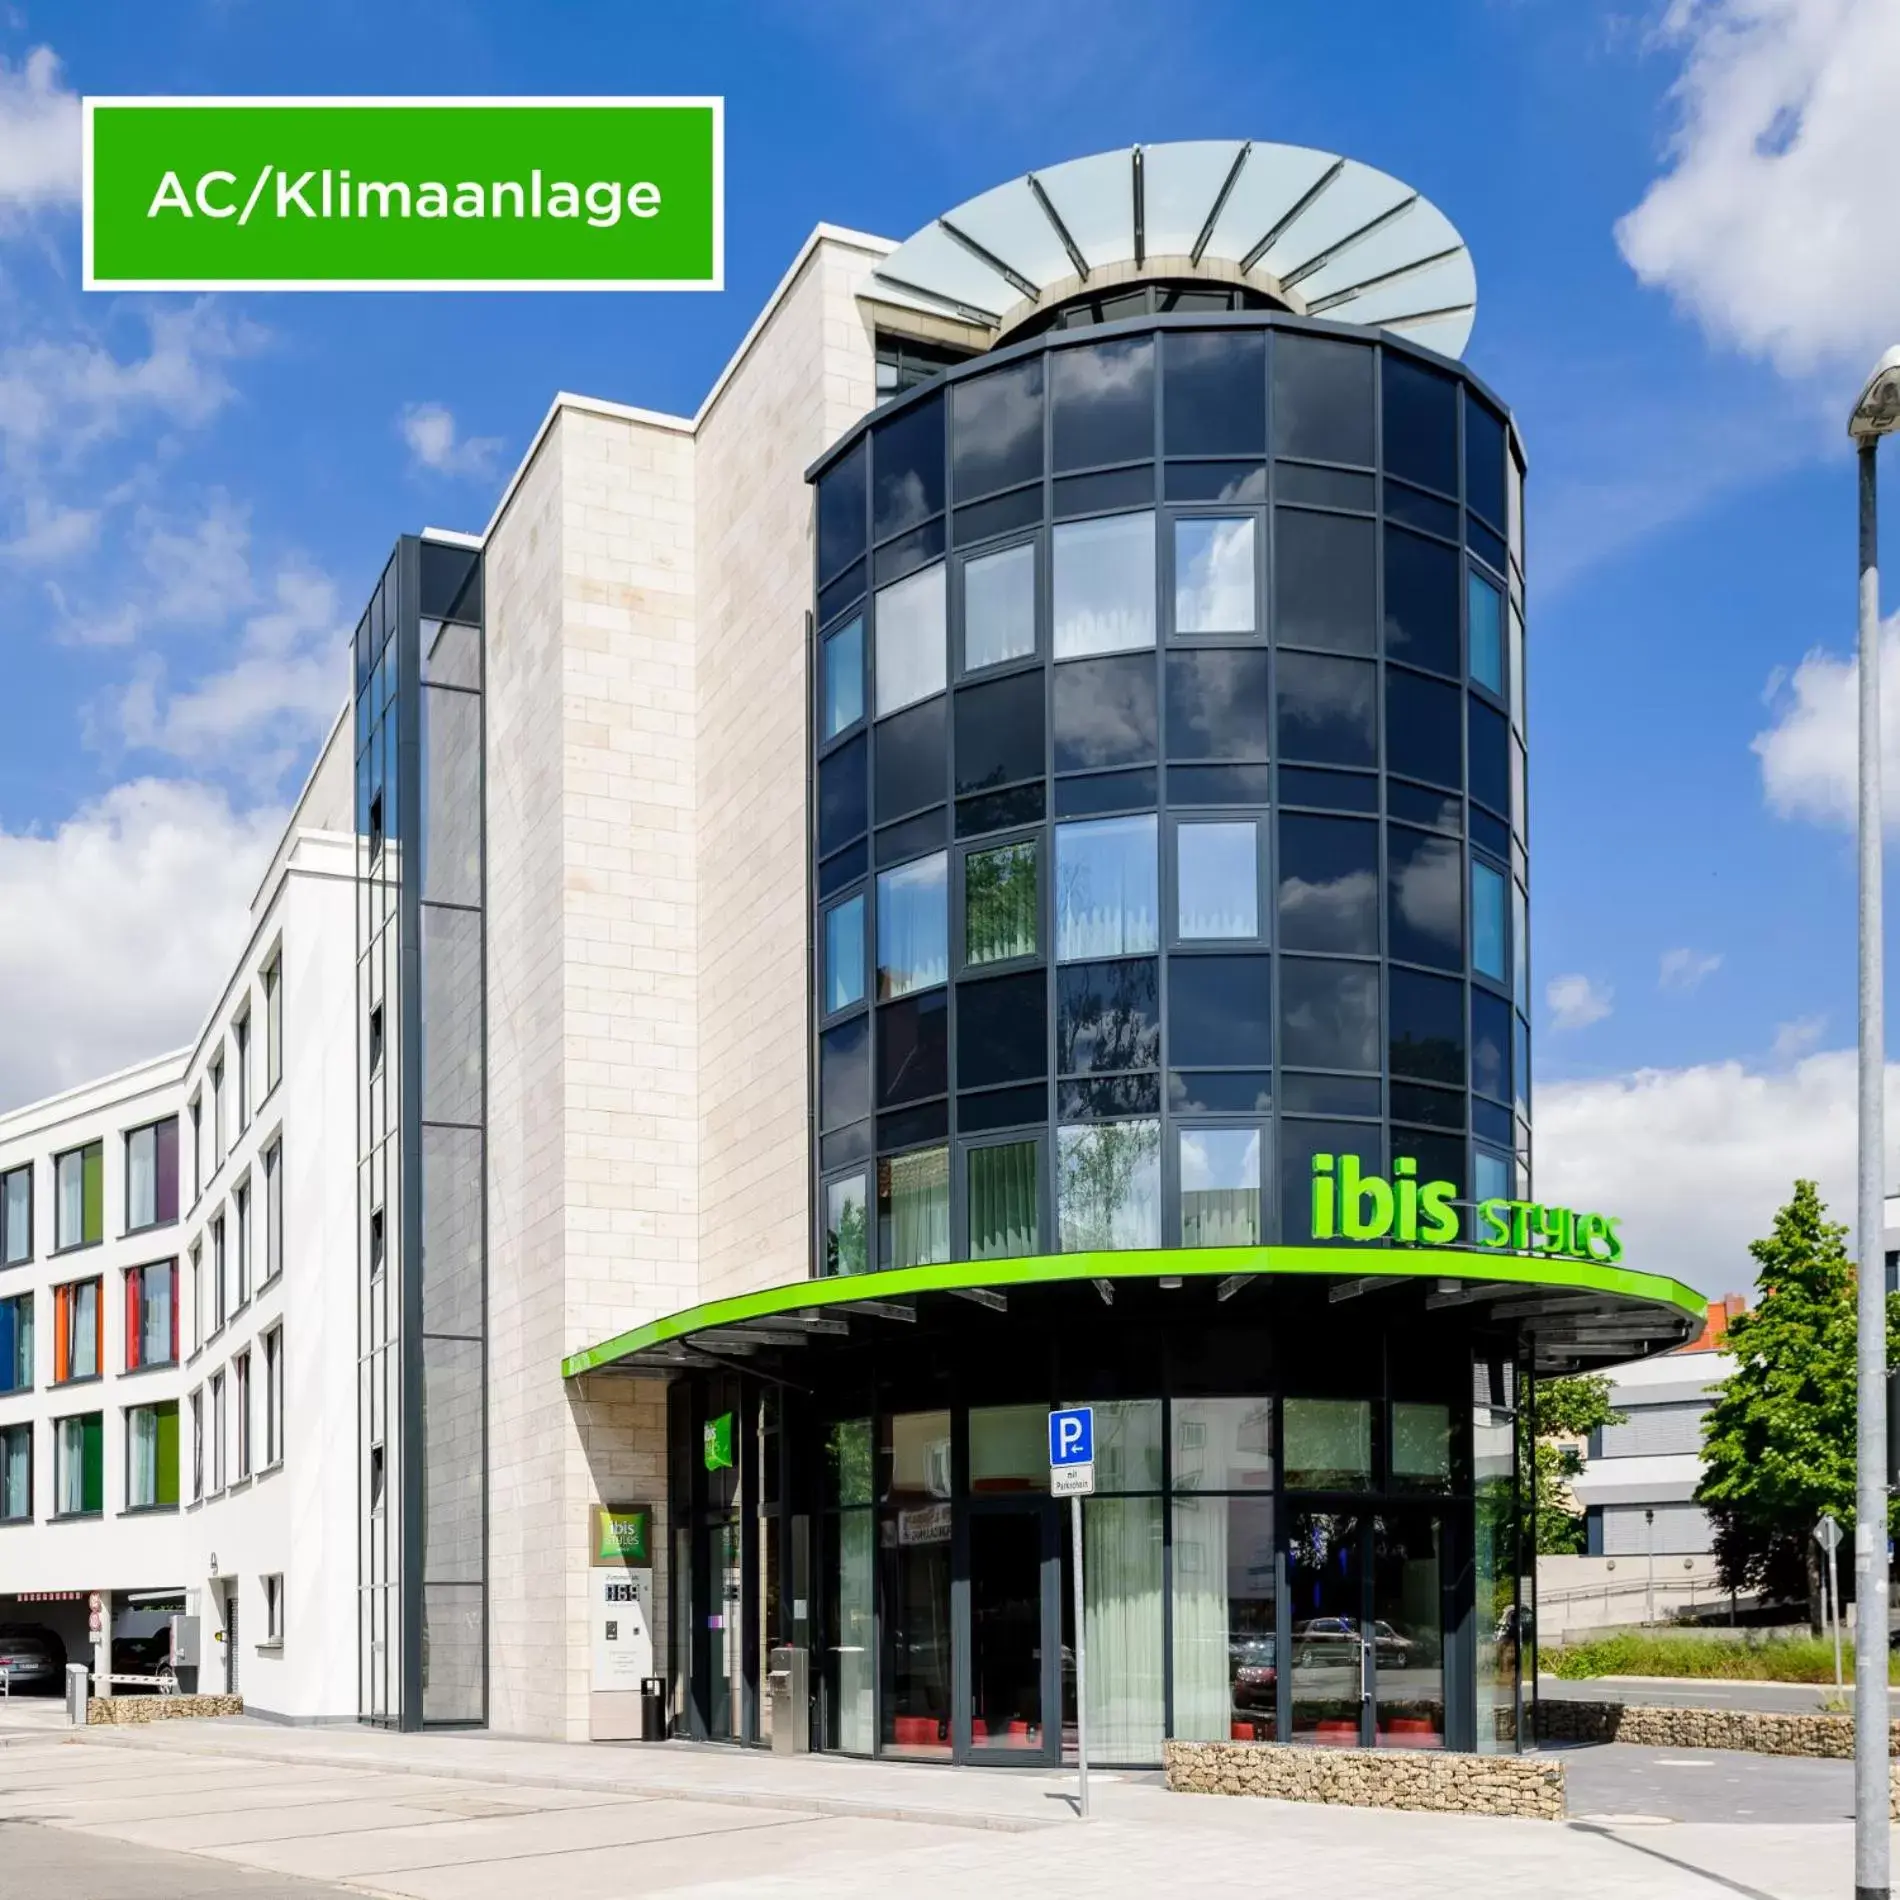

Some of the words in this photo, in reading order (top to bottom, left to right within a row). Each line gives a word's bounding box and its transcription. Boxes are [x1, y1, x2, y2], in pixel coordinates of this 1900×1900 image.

[1311, 1153, 1460, 1245] ibis
[1060, 1417, 1082, 1458] P
[609, 1520, 635, 1535] ibis
